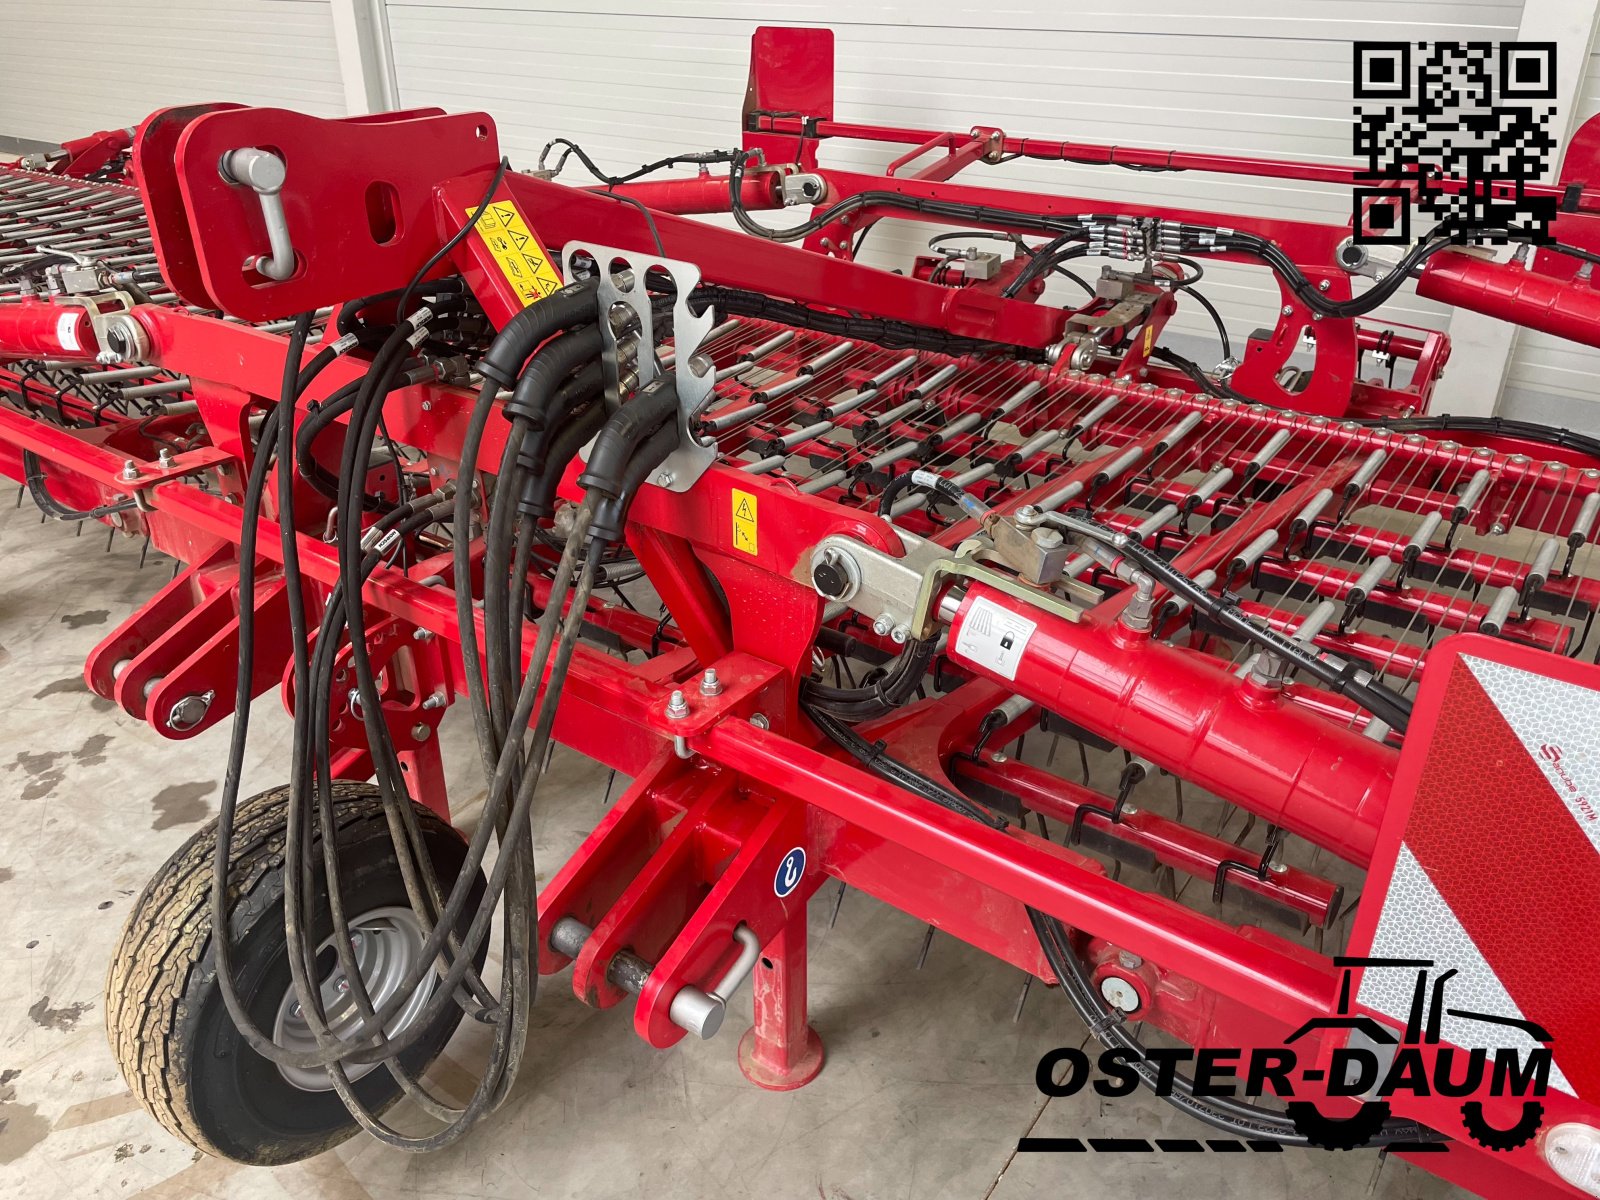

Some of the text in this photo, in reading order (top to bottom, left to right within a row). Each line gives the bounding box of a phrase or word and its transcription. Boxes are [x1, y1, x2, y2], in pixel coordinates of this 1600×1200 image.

[1261, 628, 1276, 641] IN
[1281, 640, 1317, 663] ITALY
[1539, 743, 1577, 793] Sanube
